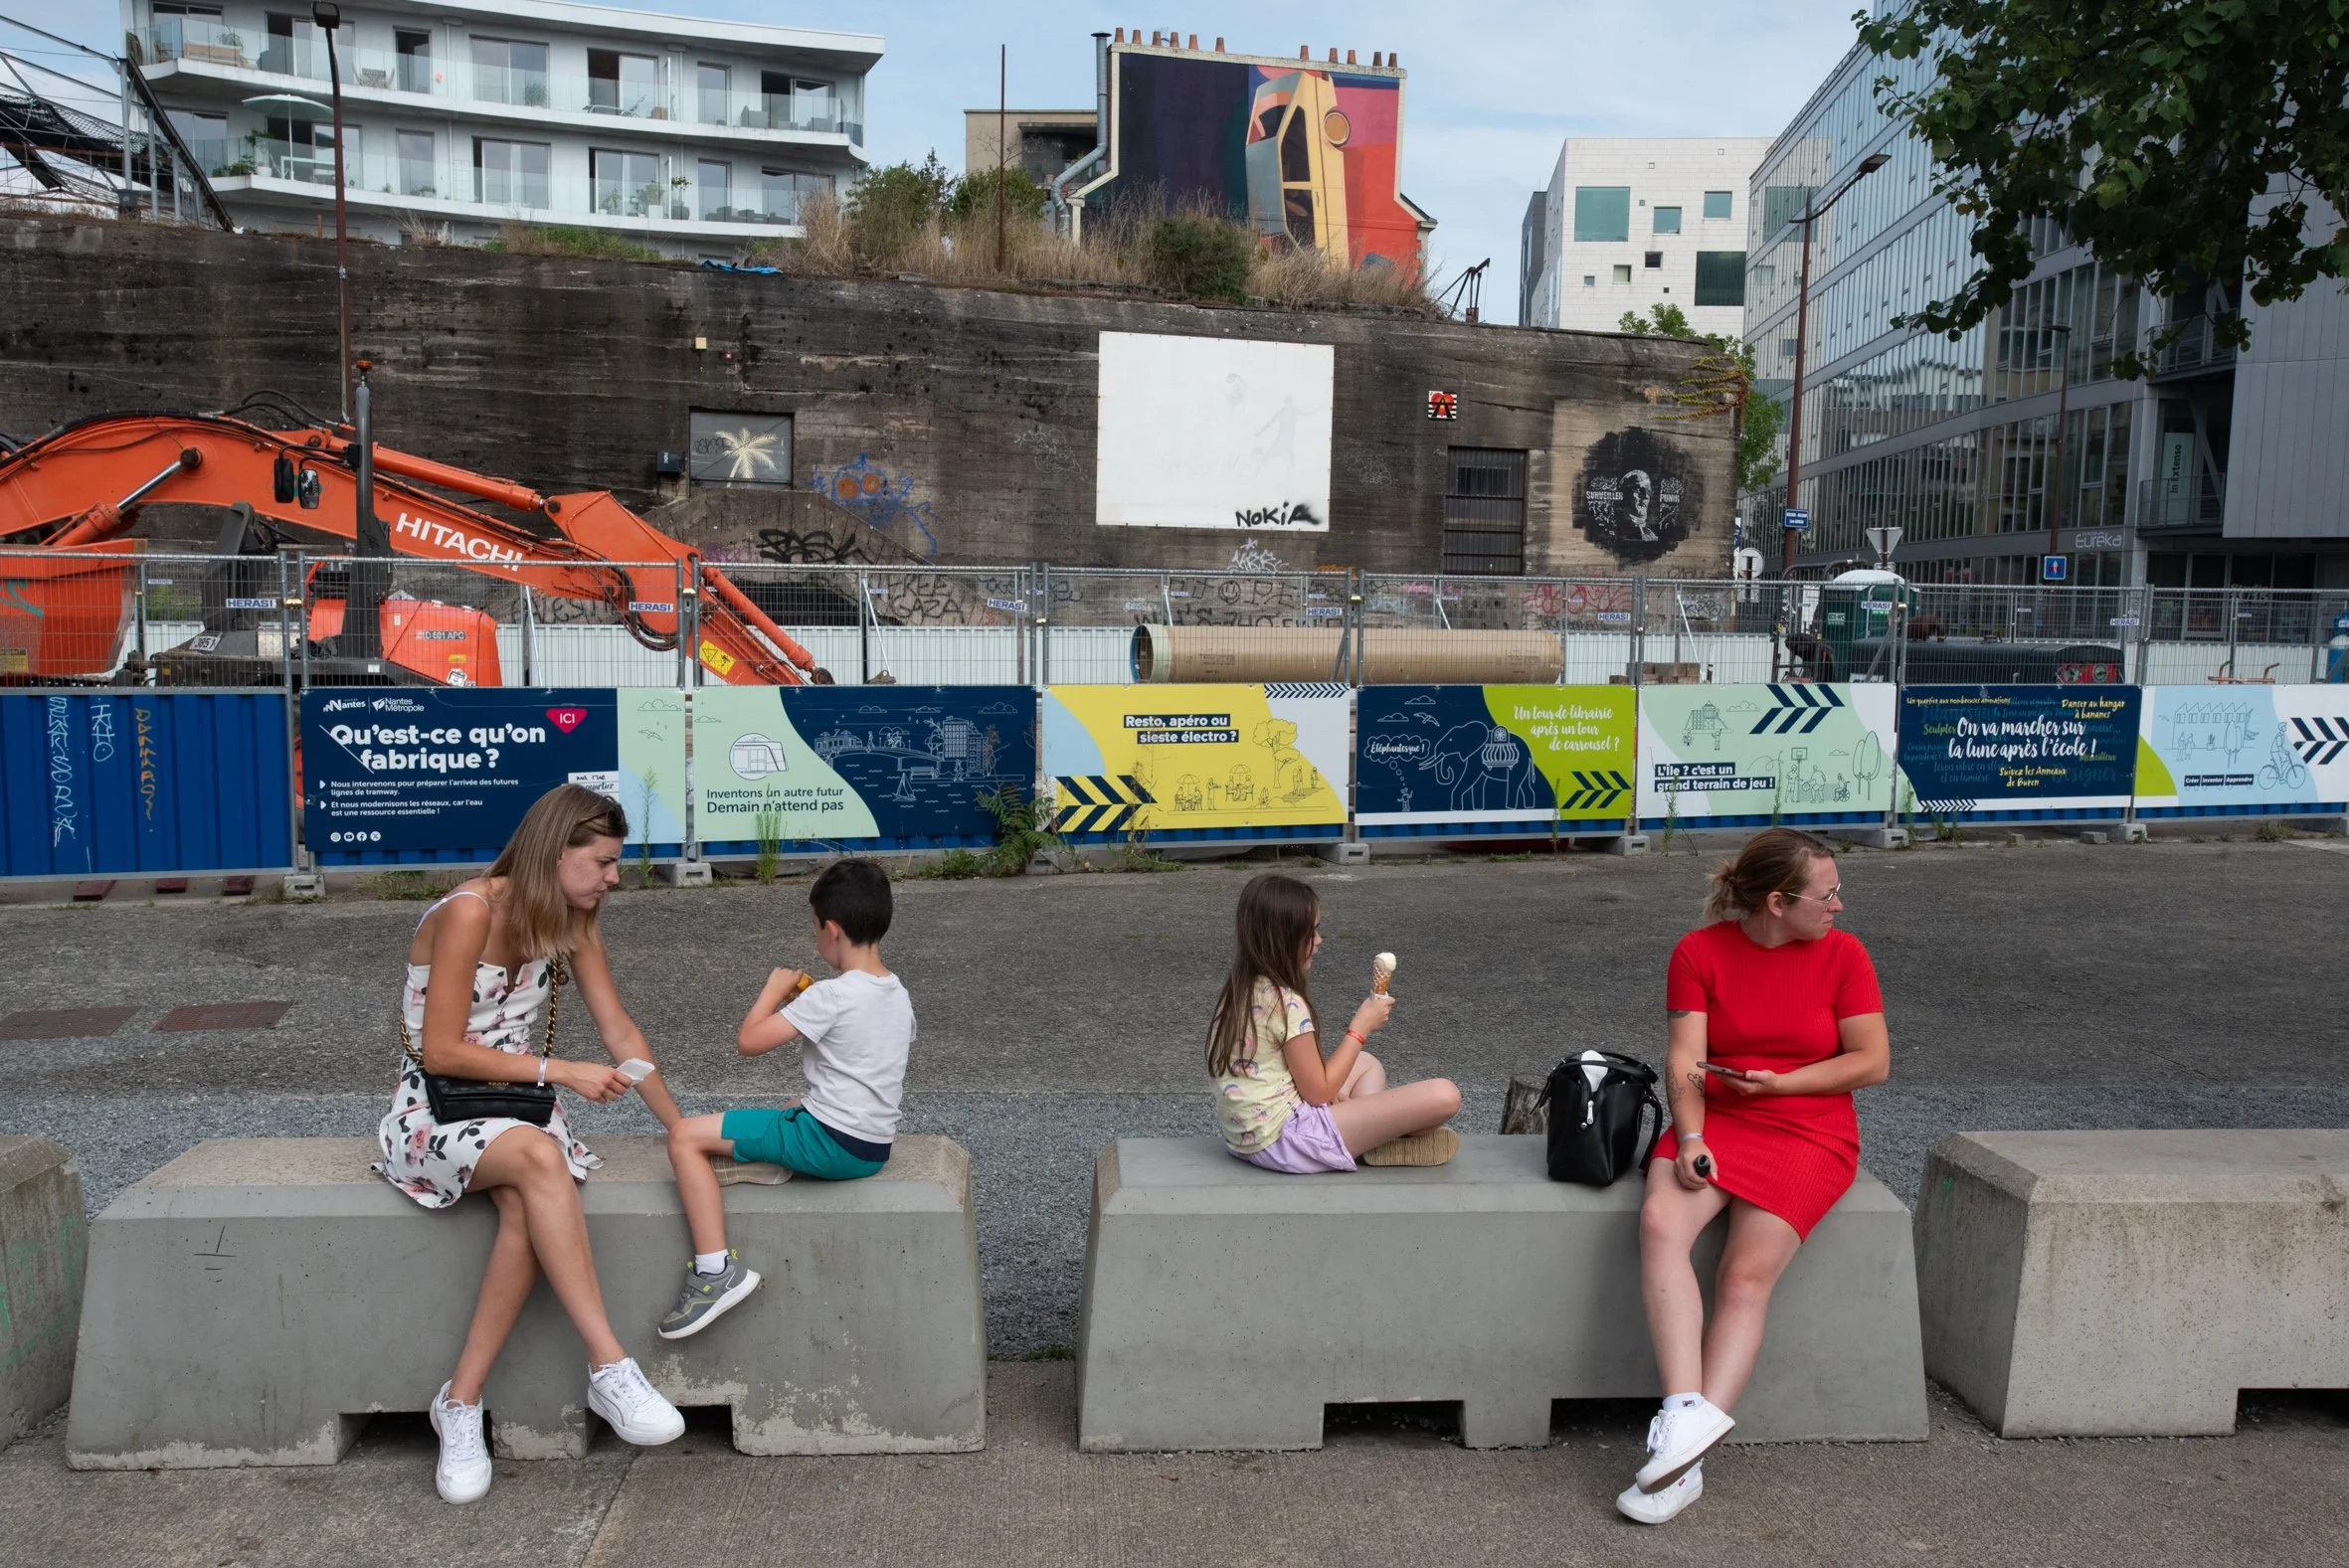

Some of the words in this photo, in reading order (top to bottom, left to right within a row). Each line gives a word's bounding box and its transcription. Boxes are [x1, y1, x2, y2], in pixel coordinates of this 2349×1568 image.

[395, 512, 523, 572] HITACHI
[2075, 531, 2122, 549] Eurêka
[892, 597, 965, 623] GAZA
[385, 704, 425, 713] Métropole
[2062, 699, 2086, 708] Danser
[2099, 696, 2125, 712] hangar
[559, 713, 576, 724] ICI
[1514, 705, 1531, 720] Un
[1533, 705, 1554, 720] tour
[1554, 703, 1568, 720] de
[1569, 703, 1614, 720] librairie
[2075, 709, 2079, 719] à
[2080, 708, 2111, 719] bananes
[1125, 716, 1167, 728] Resto,
[1169, 715, 1208, 728] apéro
[1210, 716, 1228, 726] ou
[1957, 716, 1980, 737] On
[1981, 722, 1999, 736] va
[2001, 714, 2061, 737] marcher
[2062, 721, 2086, 736] sur
[330, 724, 461, 745] Qu'est-ce
[469, 723, 546, 748] qu'on
[1140, 731, 1178, 743] sieste
[1180, 731, 1228, 742] électro
[1229, 730, 1237, 742] ?
[1531, 721, 1559, 738] après
[1561, 725, 1576, 735] un
[1577, 721, 1600, 735] tour
[1421, 743, 1425, 753] !
[1548, 736, 1561, 751] de
[1563, 736, 1612, 751] carrousel
[1614, 736, 1620, 752] ?
[1948, 738, 1964, 760] la
[1966, 737, 2000, 759] lune
[1999, 738, 2038, 763] après
[2041, 736, 2088, 757] l'école
[2090, 738, 2096, 758] !
[360, 747, 482, 774] fabrique
[485, 748, 500, 769] ?
[1683, 766, 1690, 775] ?
[1691, 765, 1717, 776] c'est
[1718, 766, 1733, 775] un
[1999, 767, 2023, 777] Suivez
[2025, 765, 2034, 776] les
[2036, 766, 2067, 776] Anneaux
[1657, 780, 1691, 792] grand
[1693, 779, 1730, 789] terrain
[1732, 779, 1747, 788] de
[1748, 778, 1767, 790] jeu
[1769, 778, 1774, 787] !
[2006, 777, 2015, 787] de
[2017, 778, 2040, 786] Buren
[706, 788, 763, 798] Inventons
[766, 788, 781, 798] un
[784, 787, 813, 796] autre
[816, 786, 844, 796] futur
[707, 800, 760, 813] Demain
[763, 799, 817, 812] n'attend
[821, 800, 844, 813] pas
